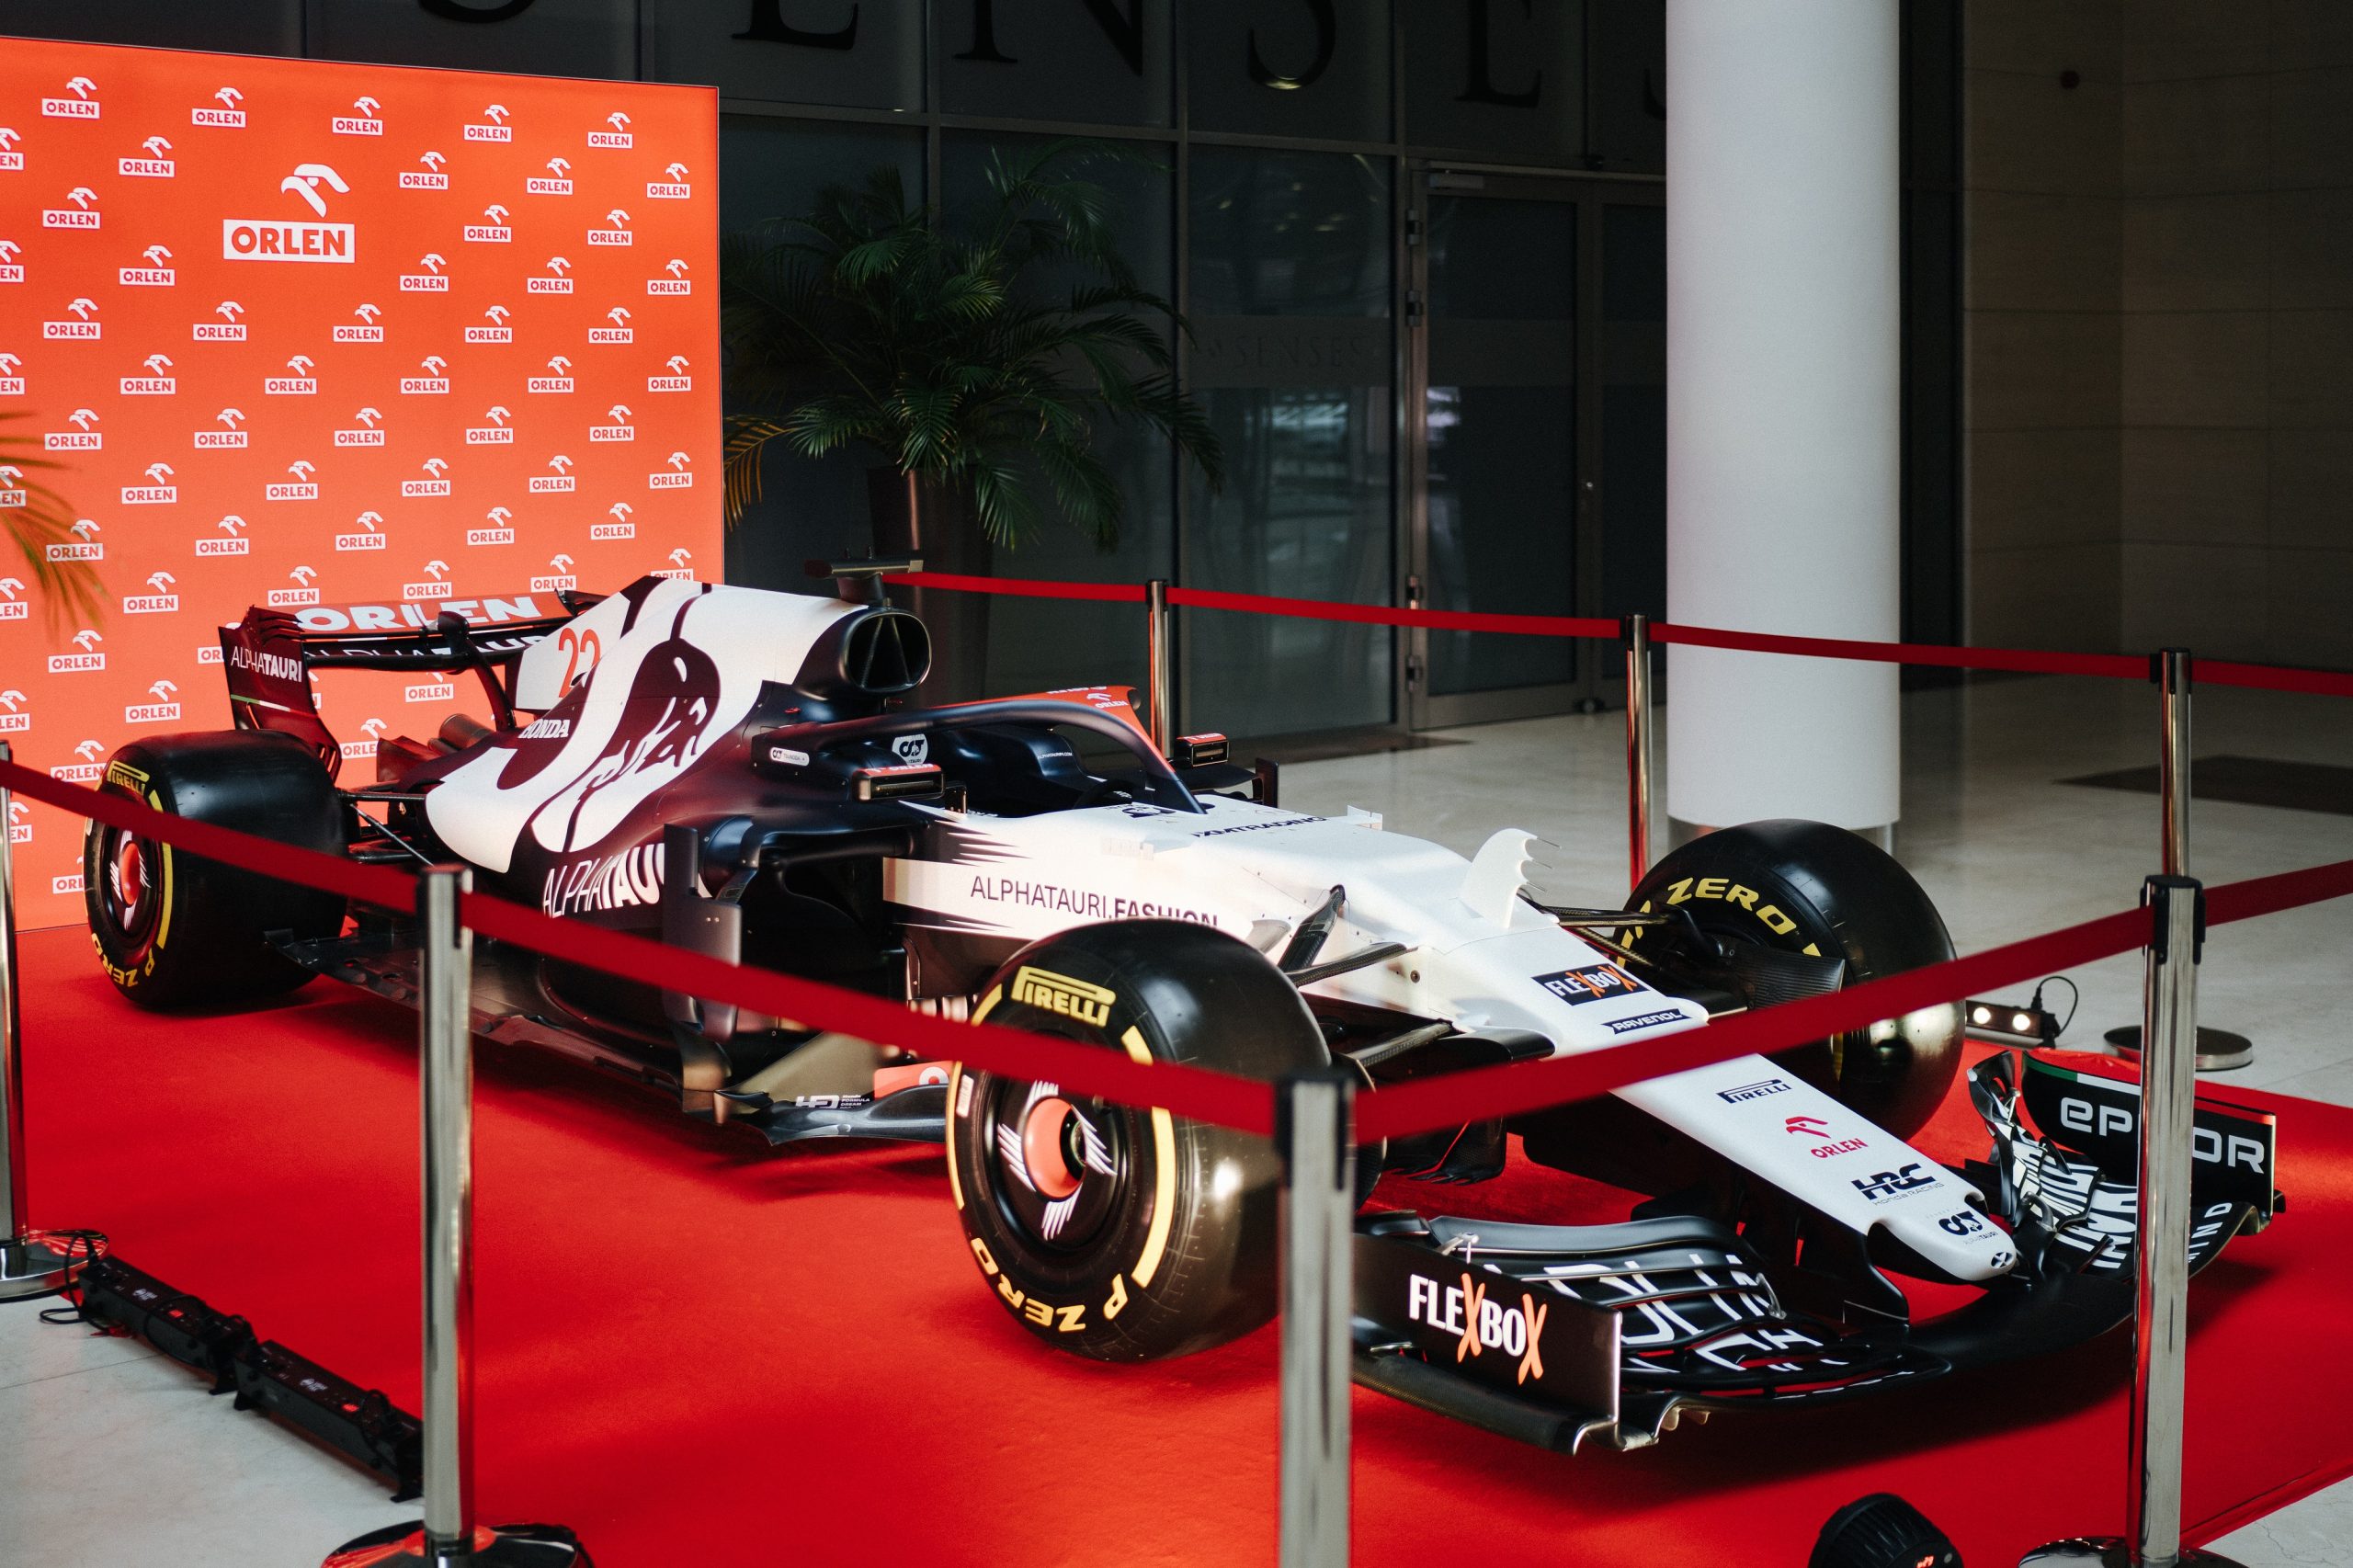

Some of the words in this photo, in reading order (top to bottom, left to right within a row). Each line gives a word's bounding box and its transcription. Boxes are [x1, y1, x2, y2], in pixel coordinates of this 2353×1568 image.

[45, 101, 96, 116] ORLEN
[195, 110, 242, 125] ORLEN
[335, 119, 380, 133] ORLEN
[467, 127, 508, 140] ORLEN
[590, 134, 630, 146] ORLEN
[122, 161, 170, 175] ORLEN
[403, 175, 445, 187] ORLEN
[529, 180, 570, 192] ORLEN
[649, 185, 688, 197] ORLEN
[46, 212, 97, 226] ORLEN
[231, 225, 346, 256] ORLEN
[467, 228, 508, 240] ORLEN
[590, 232, 630, 244] ORLEN
[122, 270, 171, 283] ORLEN
[403, 278, 446, 290] ORLEN
[529, 279, 571, 291] ORLEN
[650, 282, 688, 293] ORLEN
[47, 324, 97, 336] ORLEN
[196, 326, 243, 338] ORLEN
[336, 328, 381, 340] ORLEN
[468, 329, 509, 341] ORLEN
[591, 330, 631, 341] ORLEN
[123, 380, 172, 392] ORLEN
[267, 381, 313, 392] ORLEN
[404, 381, 446, 392] ORLEN
[530, 380, 571, 391] ORLEN
[650, 379, 688, 390] ORLEN
[198, 434, 244, 446] ORLEN
[337, 432, 381, 444] ORLEN
[469, 430, 510, 442] ORLEN
[592, 428, 631, 439] ORLEN
[48, 435, 98, 448] ORLEN
[531, 479, 573, 491] ORLEN
[652, 474, 689, 486] ORLEN
[269, 485, 314, 498] ORLEN
[404, 483, 448, 494] ORLEN
[125, 489, 173, 502] ORLEN
[470, 530, 511, 543] ORLEN
[593, 526, 632, 538] ORLEN
[199, 540, 245, 553] ORLEN
[338, 536, 382, 549] ORLEN
[49, 546, 99, 559] ORLEN
[533, 577, 574, 590] ORLEN
[270, 590, 316, 604] ORLEN
[406, 585, 449, 597] ORLEN
[127, 597, 175, 611] ORLEN
[294, 596, 542, 631] ORLEN
[51, 655, 101, 670] ORLEN
[230, 645, 302, 683] ALPHATAURI
[408, 686, 450, 699] ORLEN
[129, 705, 177, 721] ORLEN
[517, 718, 571, 739] HONDA
[342, 743, 378, 756] ORLE
[107, 759, 151, 797] PIRELLI
[55, 877, 84, 891] ORL
[542, 842, 665, 920] ALPHATAU
[1665, 877, 1797, 936] ZERO
[91, 931, 139, 988] ZERO
[1544, 965, 1638, 998] FLEXBOX
[1012, 965, 1116, 1028] PIRELLI
[1611, 1011, 1683, 1031] RAVENOL
[1716, 1078, 1793, 1104] PIRELLI
[1810, 1137, 1870, 1159] ORLEN
[1850, 1163, 1937, 1201] HRC
[970, 1236, 1086, 1333] ZERO
[1103, 1253, 1128, 1322] P
[1408, 1272, 1548, 1386] FLEXBOX
